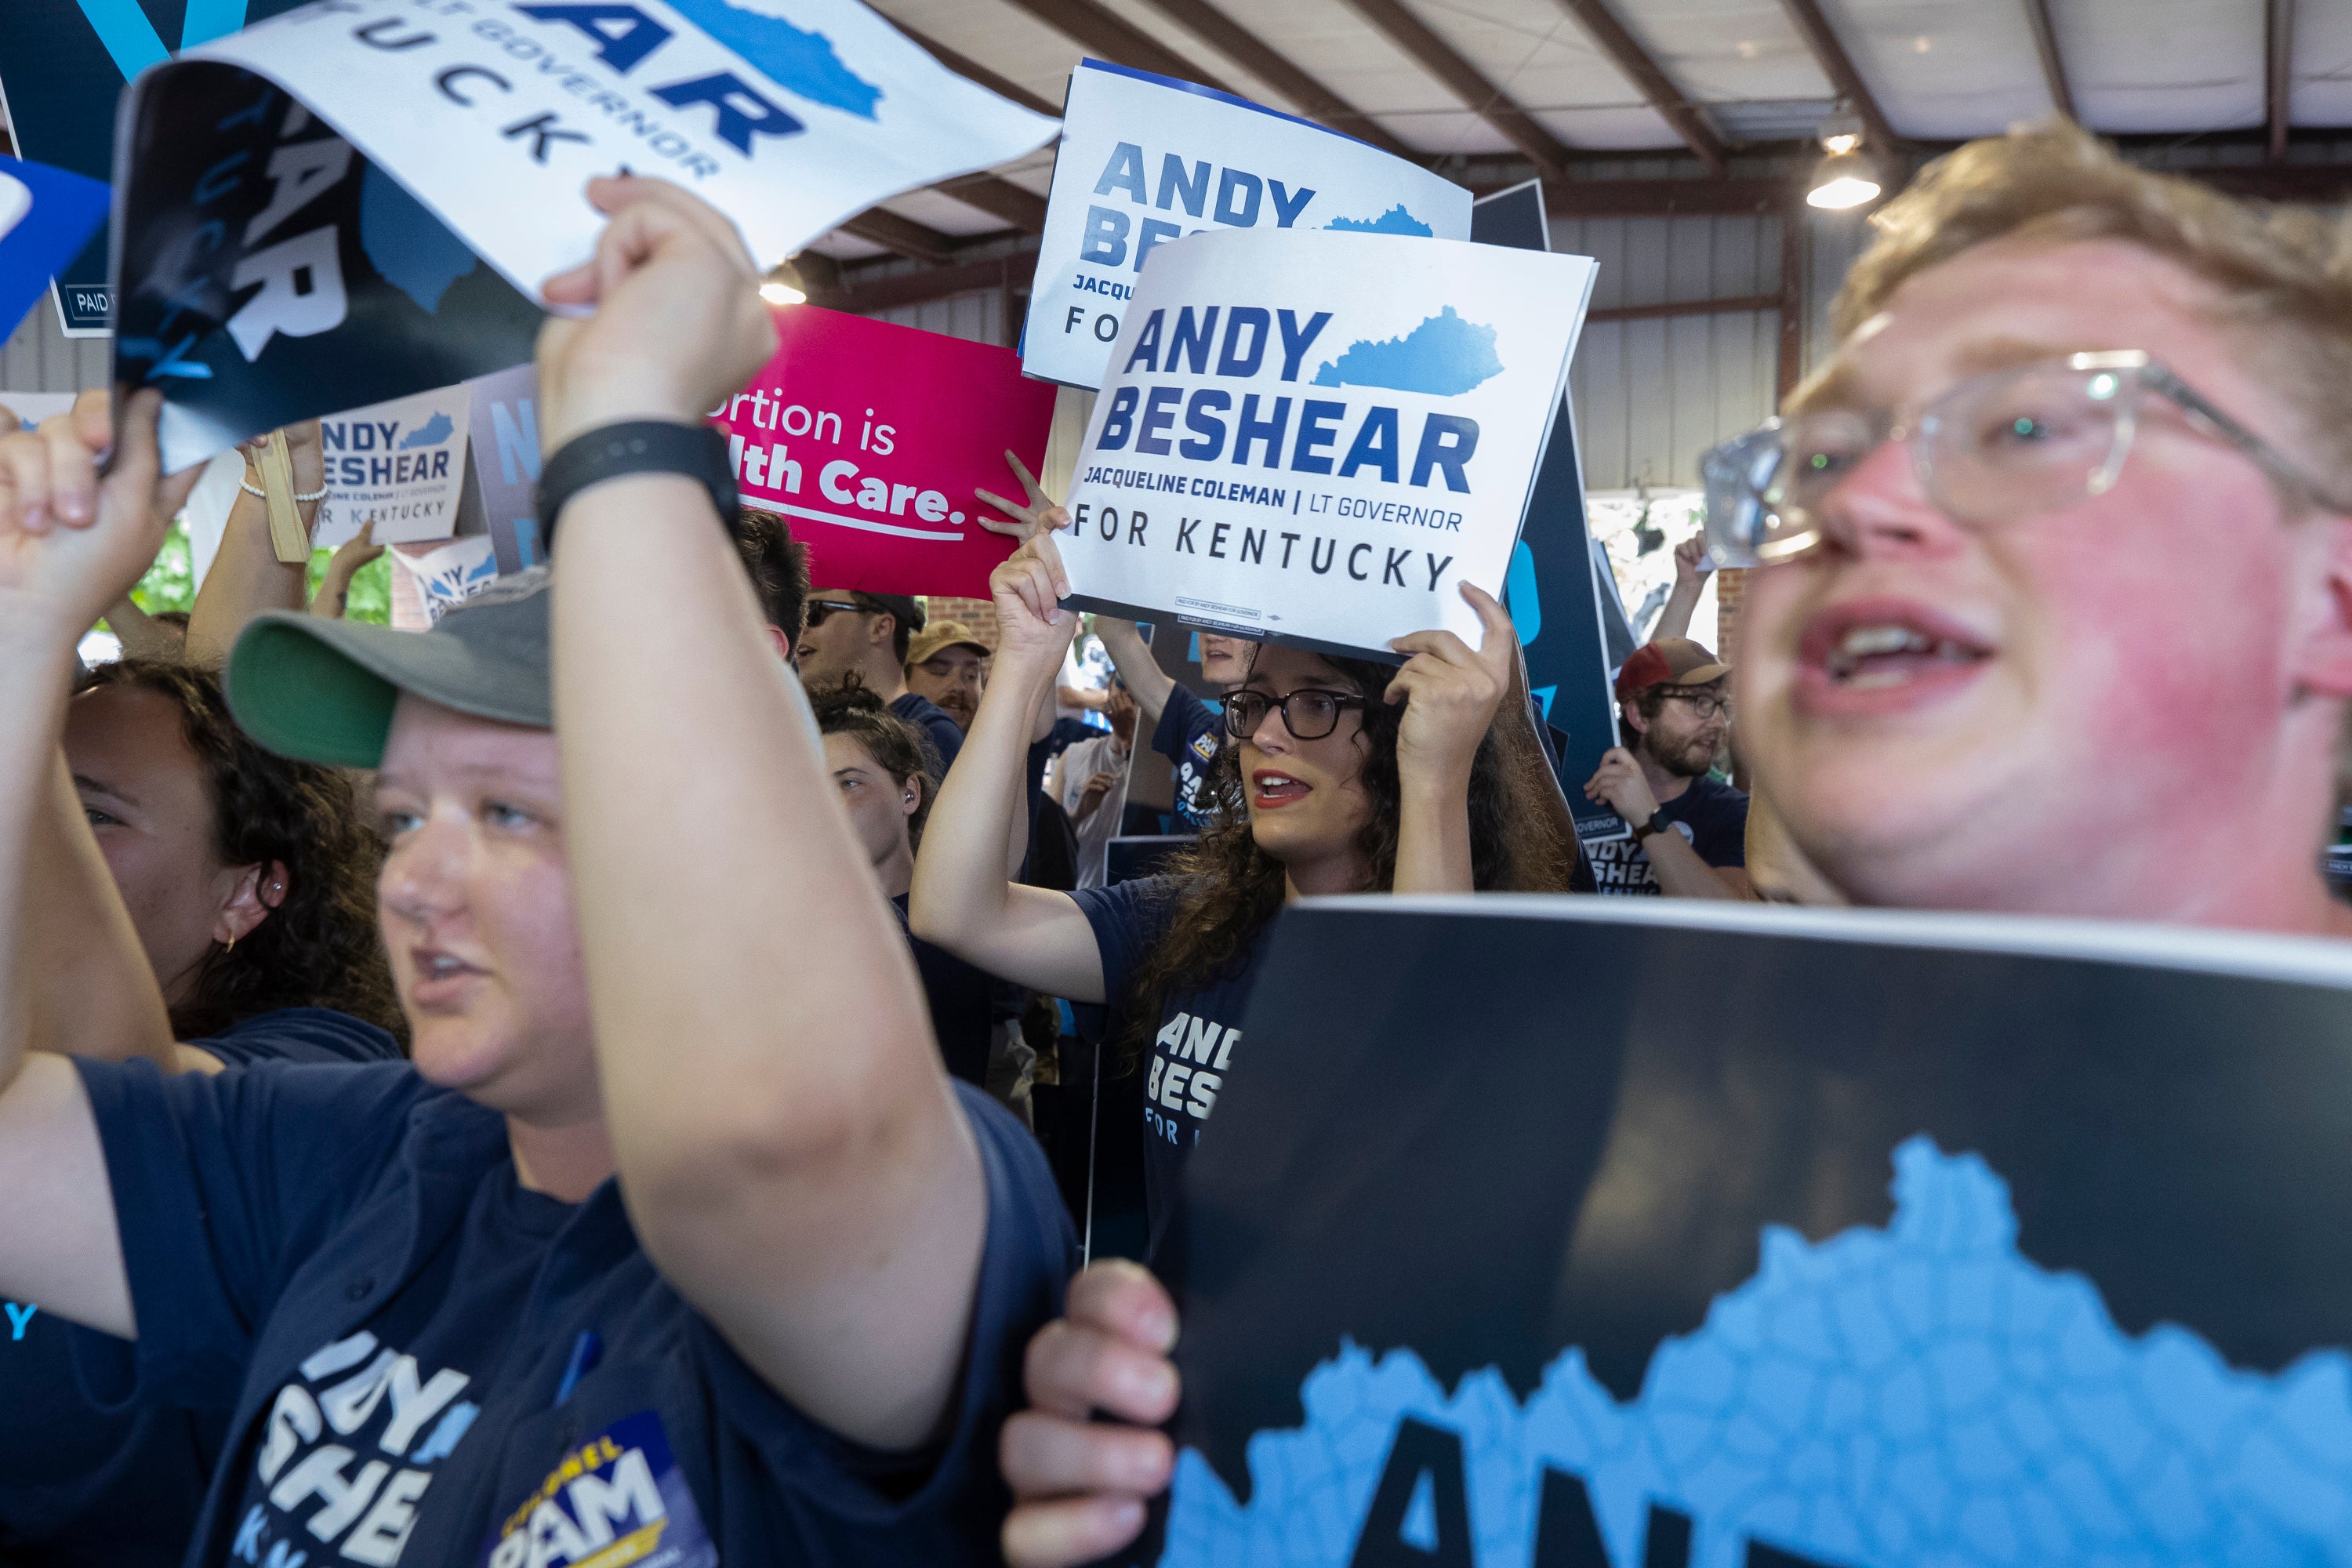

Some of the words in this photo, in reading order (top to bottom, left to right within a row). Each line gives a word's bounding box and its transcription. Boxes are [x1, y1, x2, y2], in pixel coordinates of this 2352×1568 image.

[470, 17, 721, 178] GOVERNOR
[1093, 141, 1317, 228] ANDY
[76, 292, 109, 312] PAID
[1123, 306, 1334, 382] ANDY
[860, 408, 897, 456] is
[1096, 387, 1480, 494] BESHEAR
[819, 459, 966, 524] Care.
[1083, 466, 1188, 493] JACQUELINE
[1190, 478, 1286, 507] COLEMAN
[1309, 493, 1333, 514] LT
[1338, 497, 1462, 532] GOVERNOR
[1074, 503, 1149, 546] FOR
[1175, 517, 1454, 592] KENTUCKY
[1575, 817, 1619, 833] OVERNOR
[1148, 1054, 1223, 1120] BES
